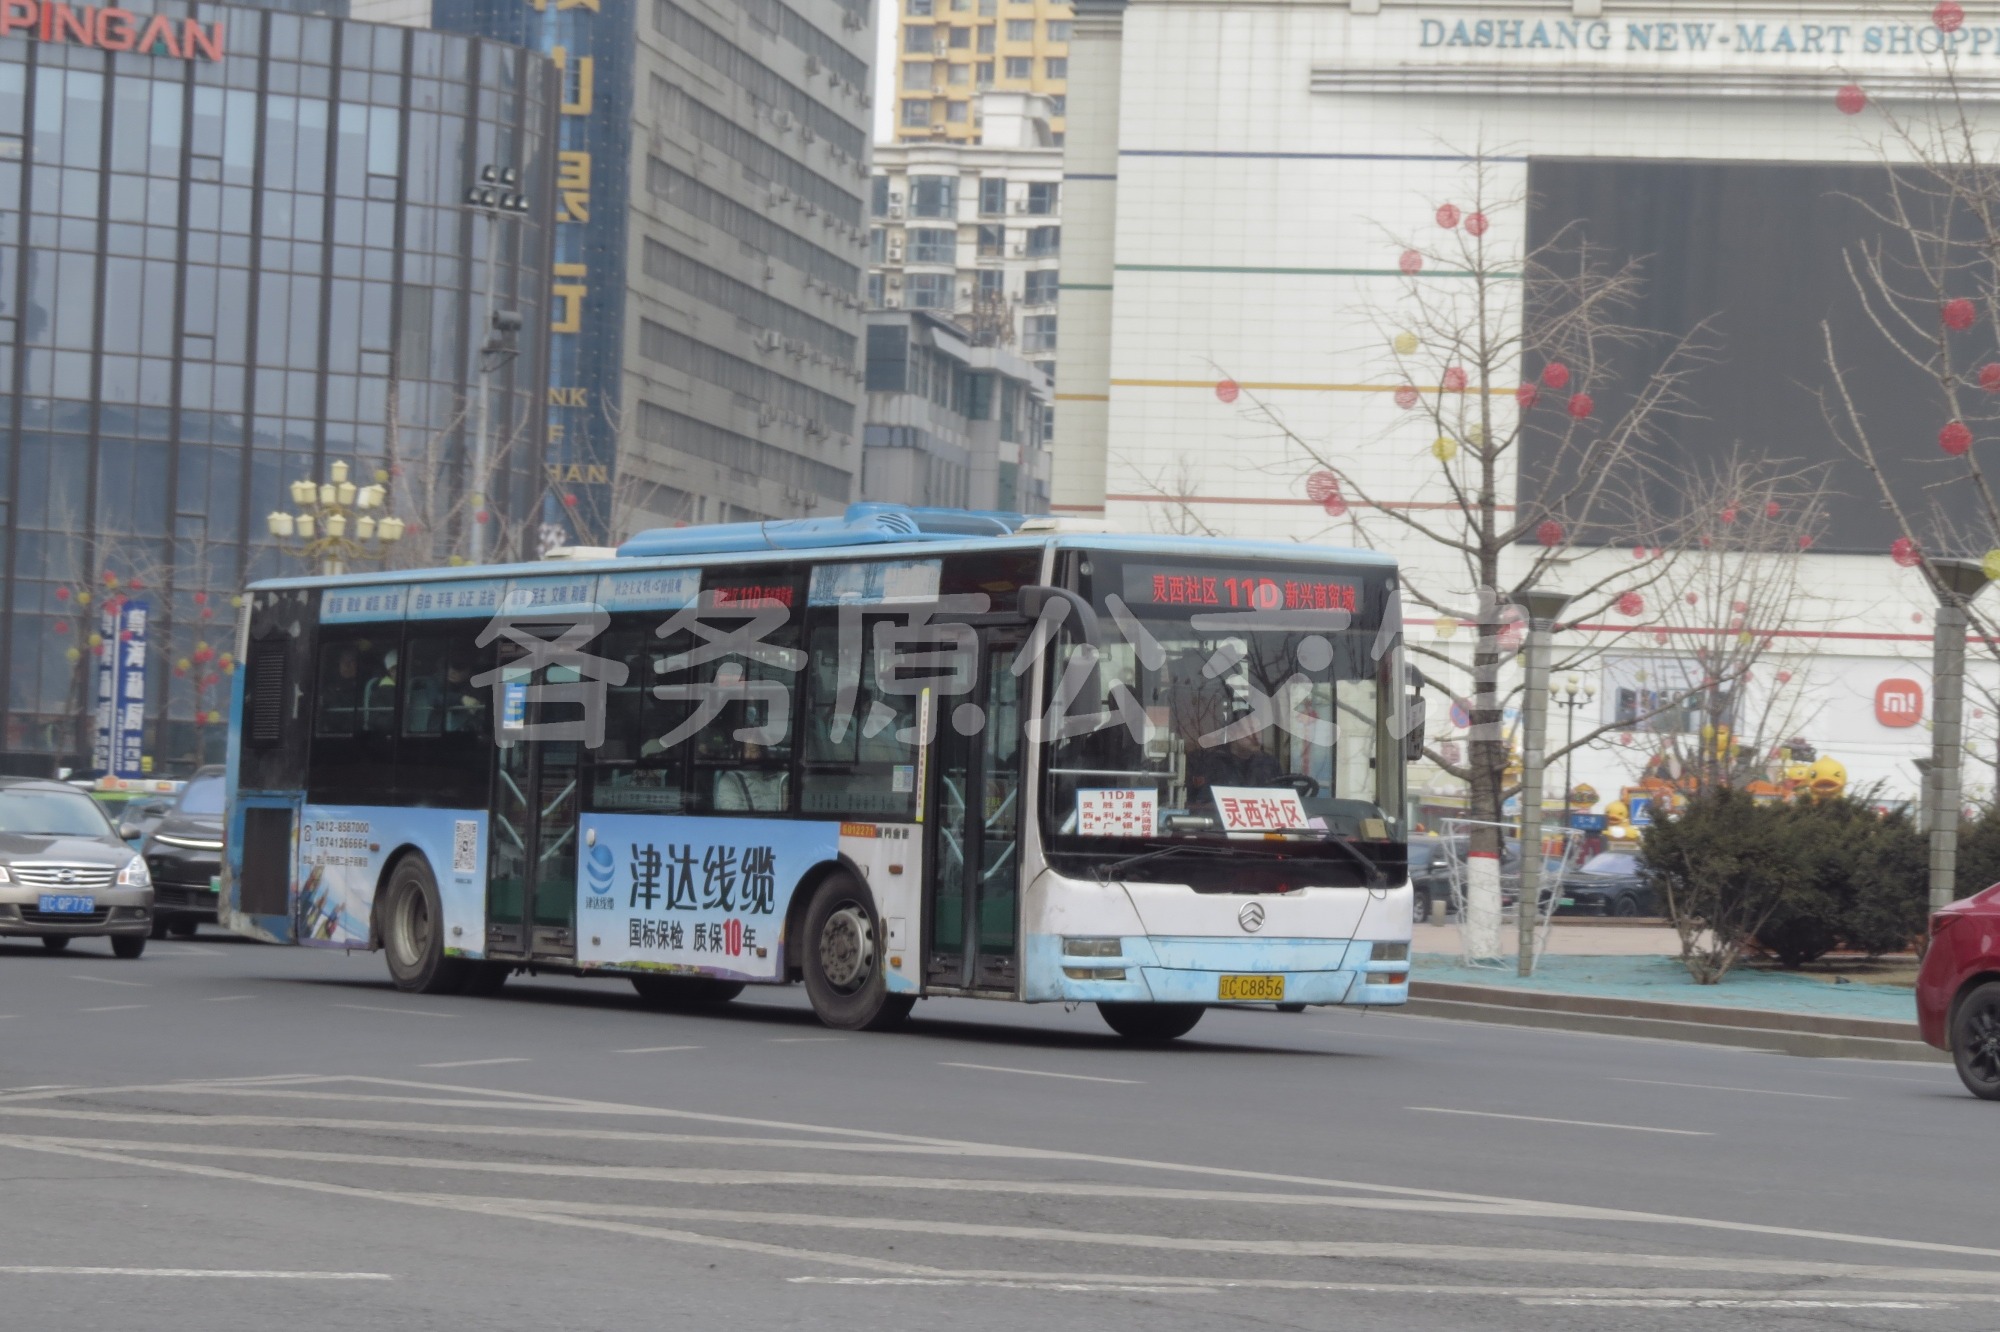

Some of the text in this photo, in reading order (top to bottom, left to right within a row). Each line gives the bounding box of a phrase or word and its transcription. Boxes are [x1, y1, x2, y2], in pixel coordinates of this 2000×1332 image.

[0, 0, 224, 62] PINGAN
[1420, 19, 1611, 50] DASHANG
[1626, 23, 1850, 53] NEW-MART
[1152, 574, 1356, 612] 灵西社区 11D 新兴商贸城
[1221, 797, 1304, 829] 灵西社区
[629, 843, 776, 914] 津达线缆
[629, 918, 757, 957] 国标保检 质保10年
